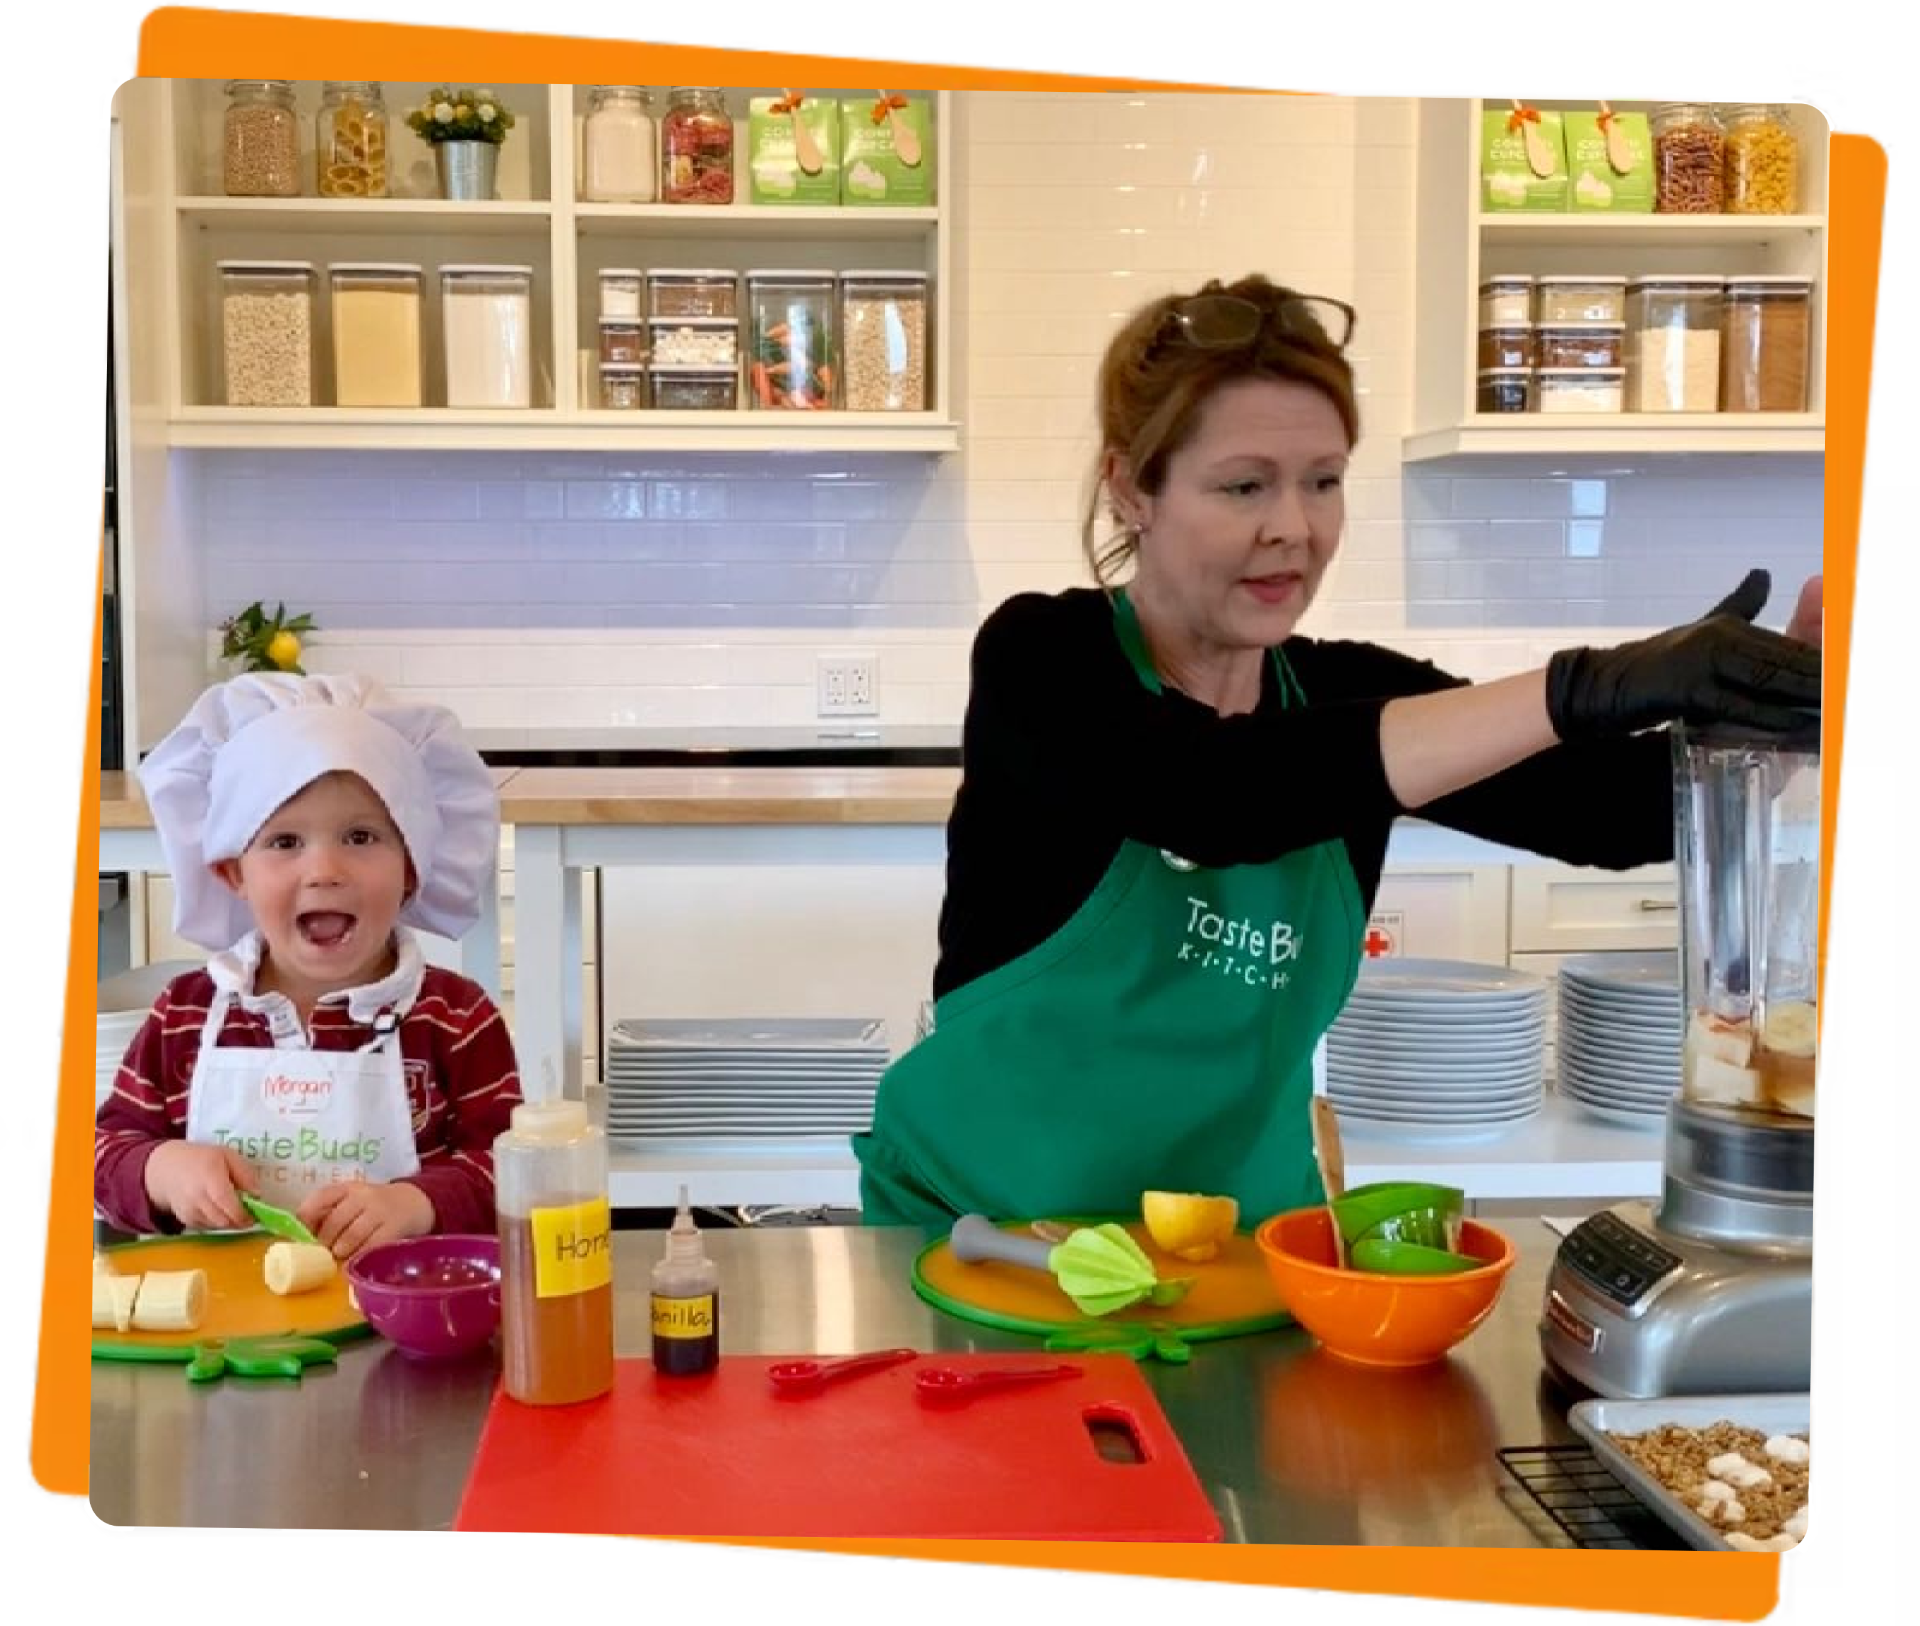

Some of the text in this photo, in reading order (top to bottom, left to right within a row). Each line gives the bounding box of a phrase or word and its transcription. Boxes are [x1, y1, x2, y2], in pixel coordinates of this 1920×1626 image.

[1186, 896, 1303, 965] TasteB
[264, 1074, 332, 1106] Morgan
[556, 1231, 609, 1263] Hon
